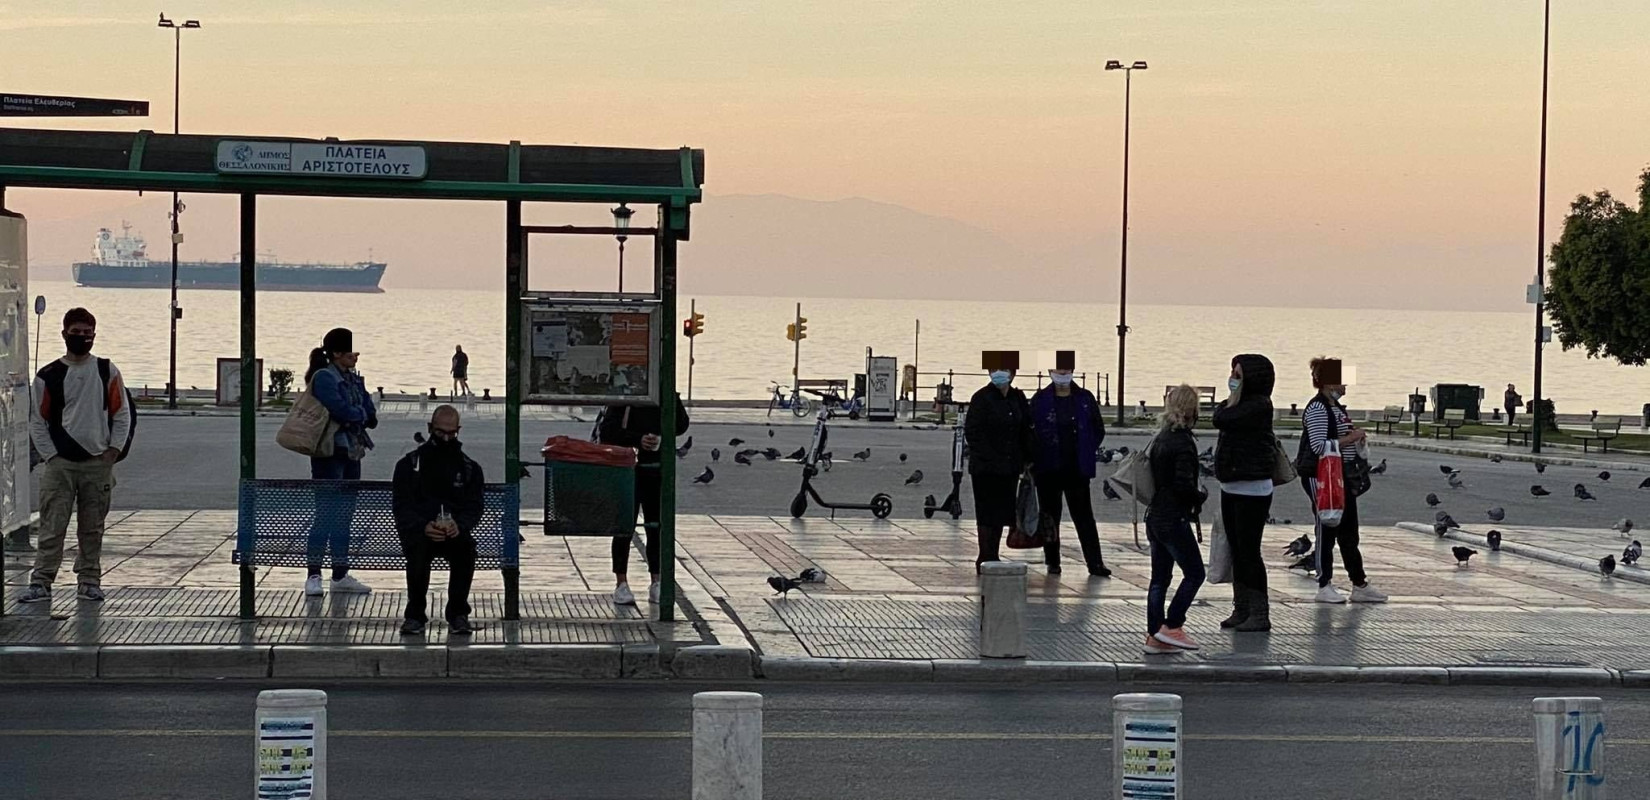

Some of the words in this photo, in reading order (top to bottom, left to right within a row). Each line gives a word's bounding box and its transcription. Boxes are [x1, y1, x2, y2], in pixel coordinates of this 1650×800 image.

[325, 146, 387, 160] ΠΛΑΤΕΙΑ
[218, 160, 291, 171] ΘΕΣΣΑΛΟΝΙΚΗΣ
[302, 160, 411, 175] ΑΡΙΣΤΟΤΕΛΟΥΣ
